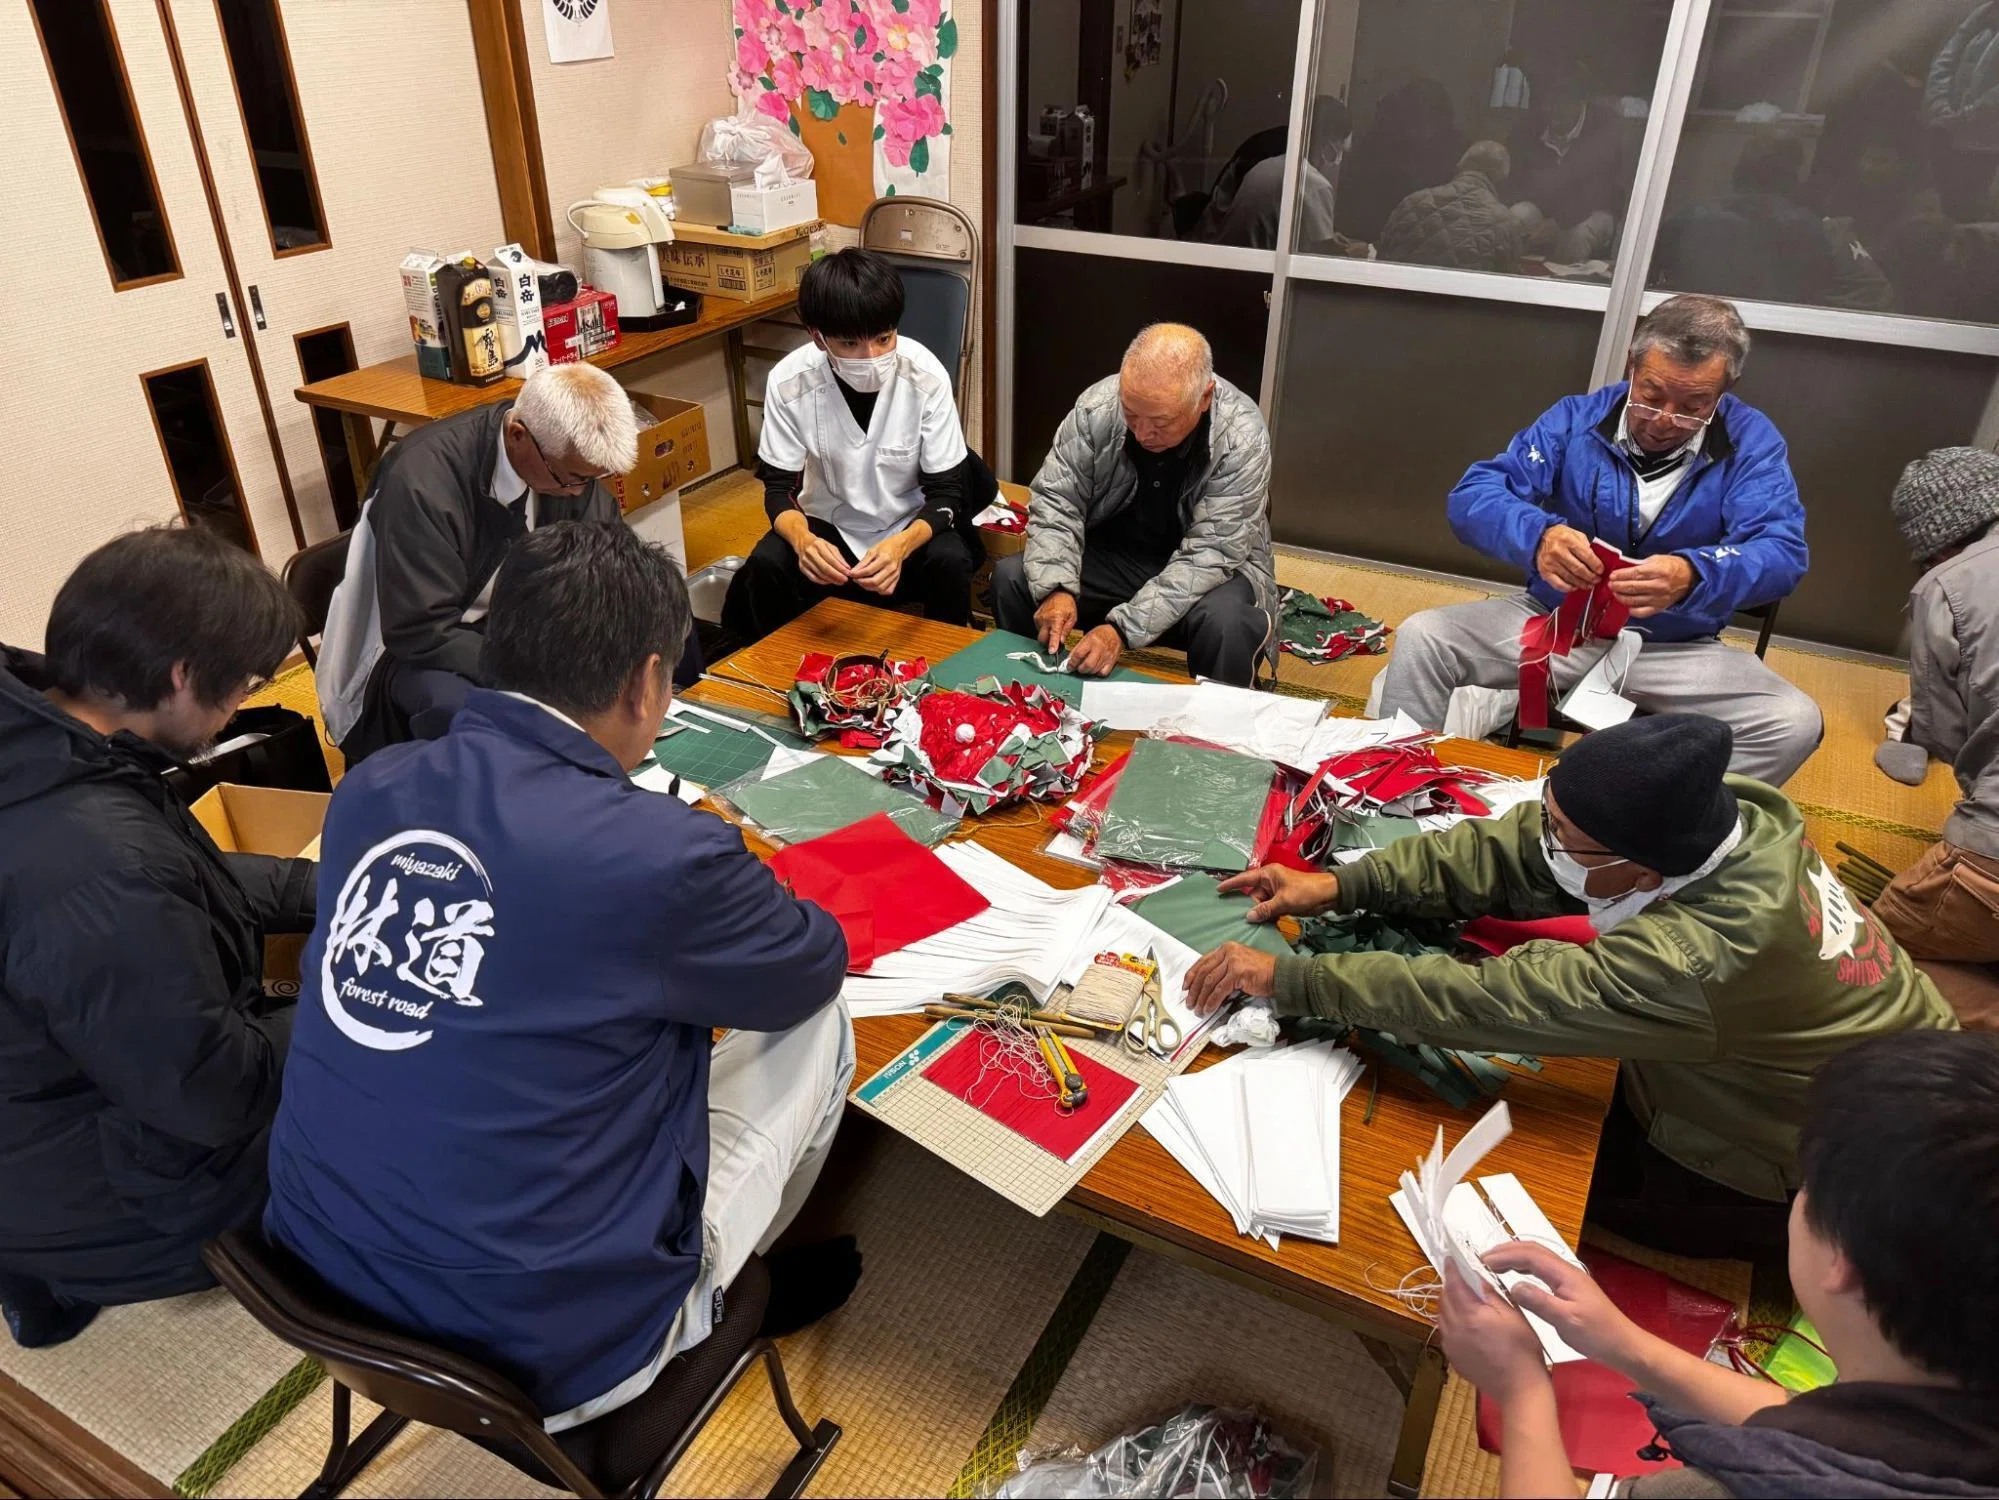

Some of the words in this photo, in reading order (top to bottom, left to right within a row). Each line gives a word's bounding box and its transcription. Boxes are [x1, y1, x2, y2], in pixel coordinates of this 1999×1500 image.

[519, 273, 534, 304] 白岳
[481, 327, 499, 368] 霧島
[390, 851, 463, 881] miyazaki
[333, 873, 496, 1008] 林道
[1836, 956, 1886, 985] SHIIBA
[339, 977, 388, 1009] forest
[389, 997, 434, 1020] road
